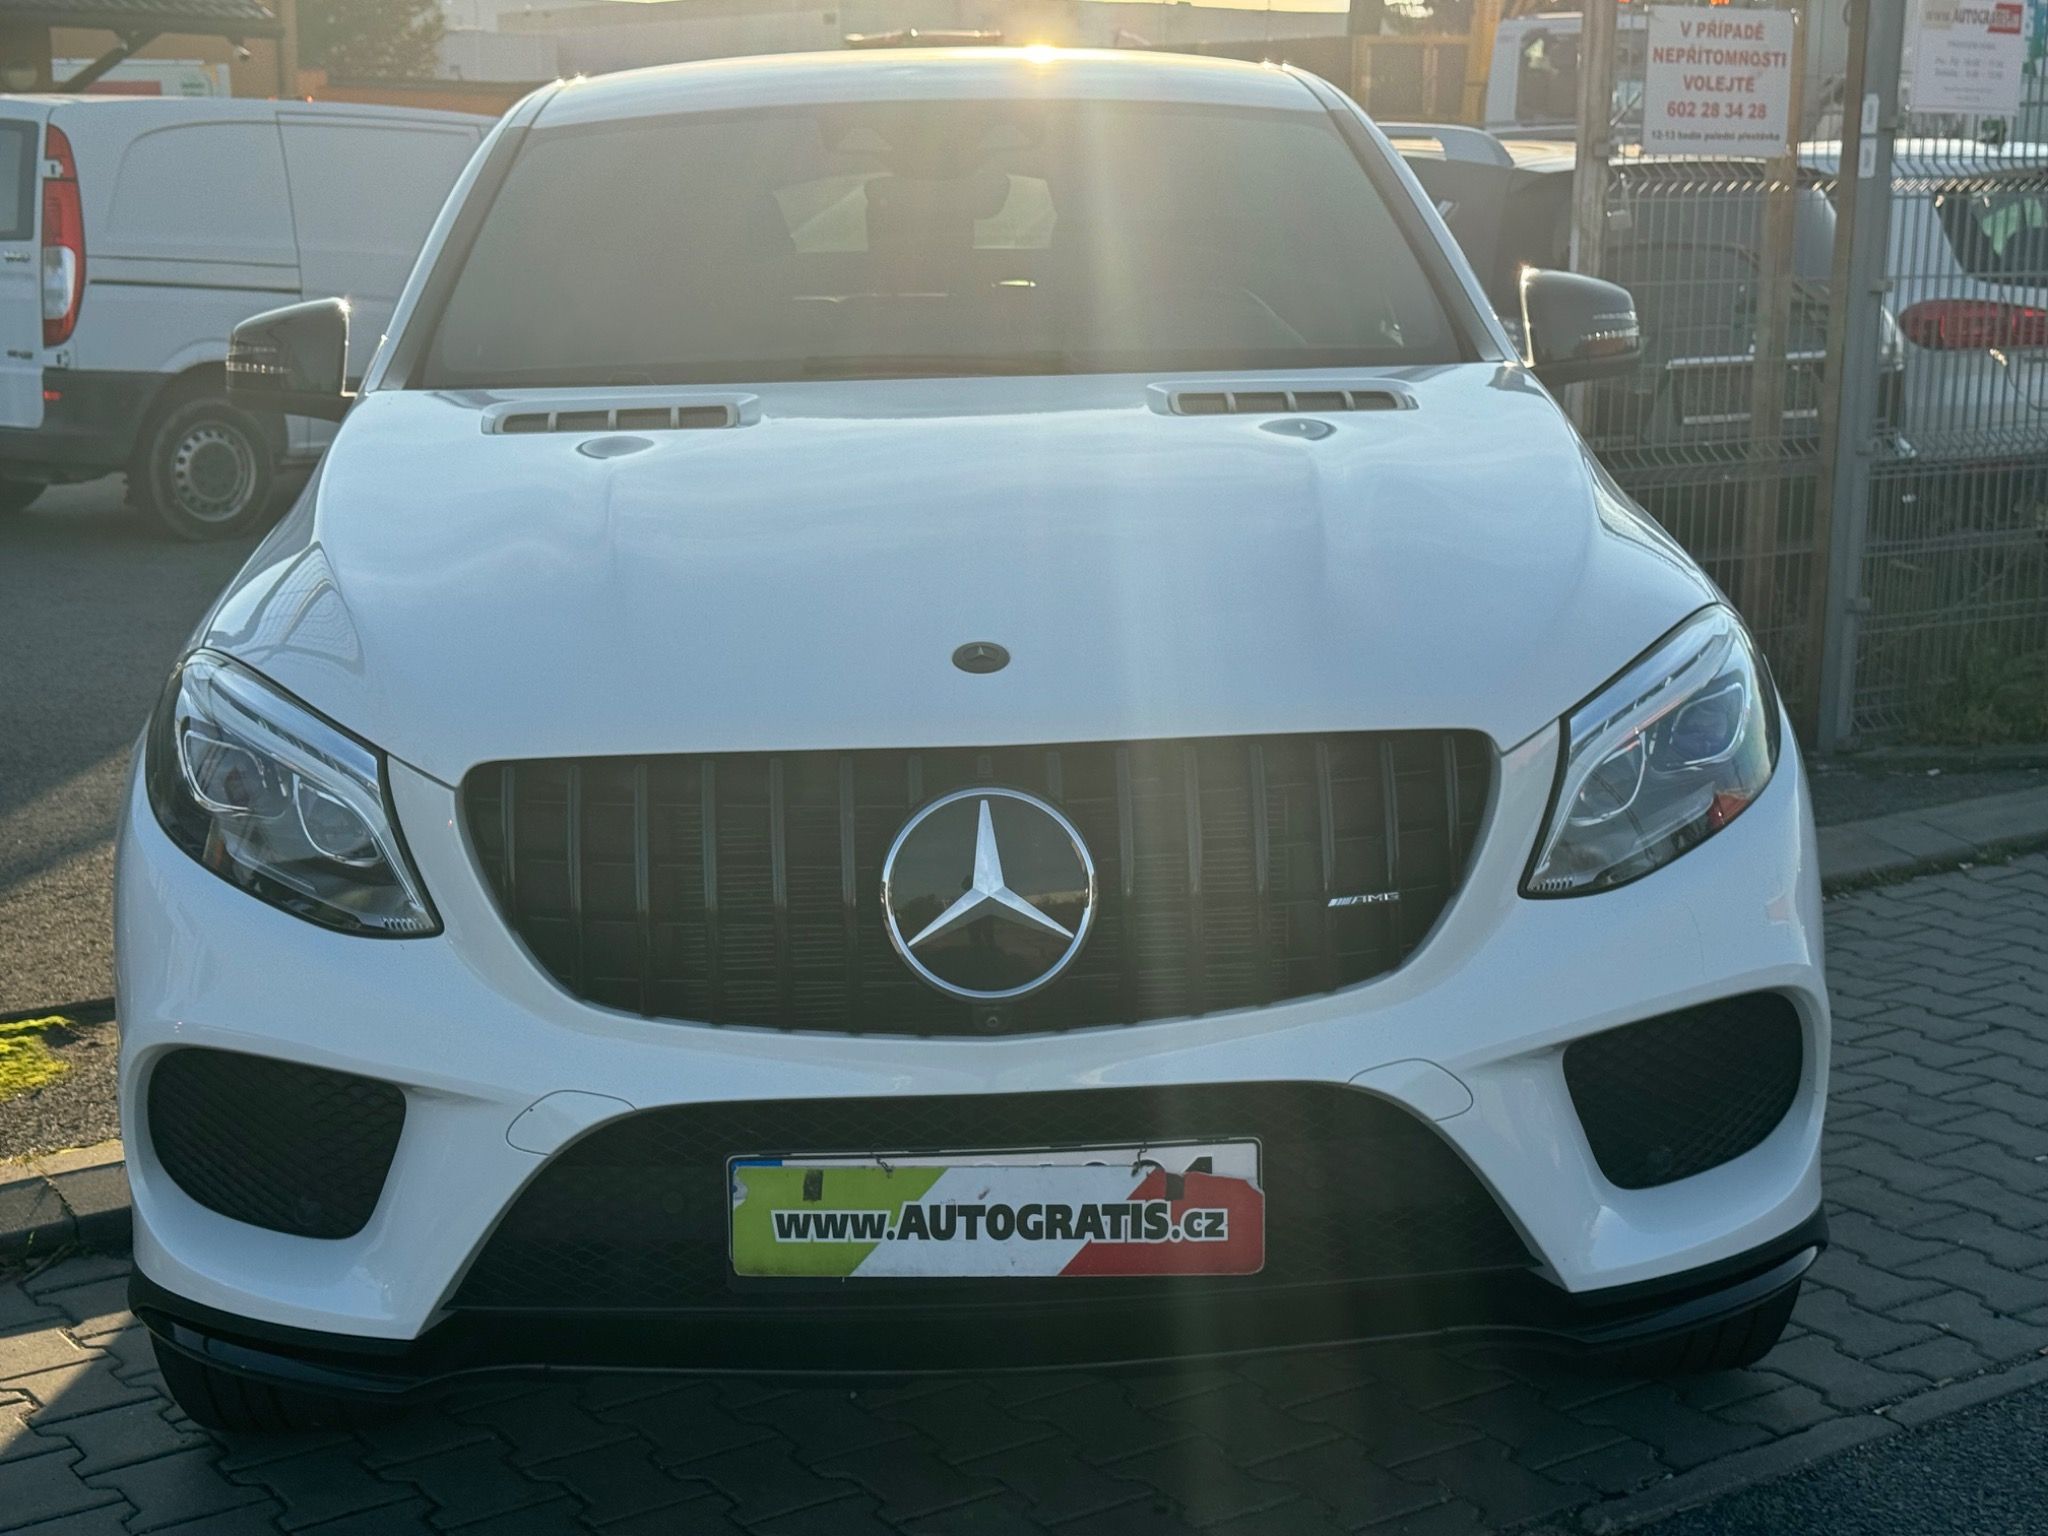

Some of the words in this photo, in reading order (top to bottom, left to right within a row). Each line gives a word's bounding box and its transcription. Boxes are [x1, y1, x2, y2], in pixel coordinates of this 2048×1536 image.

[1680, 21, 1692, 37] V
[1696, 19, 1764, 40] PŘÍPADĚ
[1652, 46, 1786, 68] NEPŘÍTOMNOSTI
[1683, 75, 1755, 93] VOLEJTE
[1667, 101, 1696, 118] 602
[1701, 102, 1720, 118] 28
[1725, 103, 1743, 119] 34
[1748, 103, 1767, 119] 28
[775, 1203, 1227, 1241] www.AUTOGRATIS.cz
